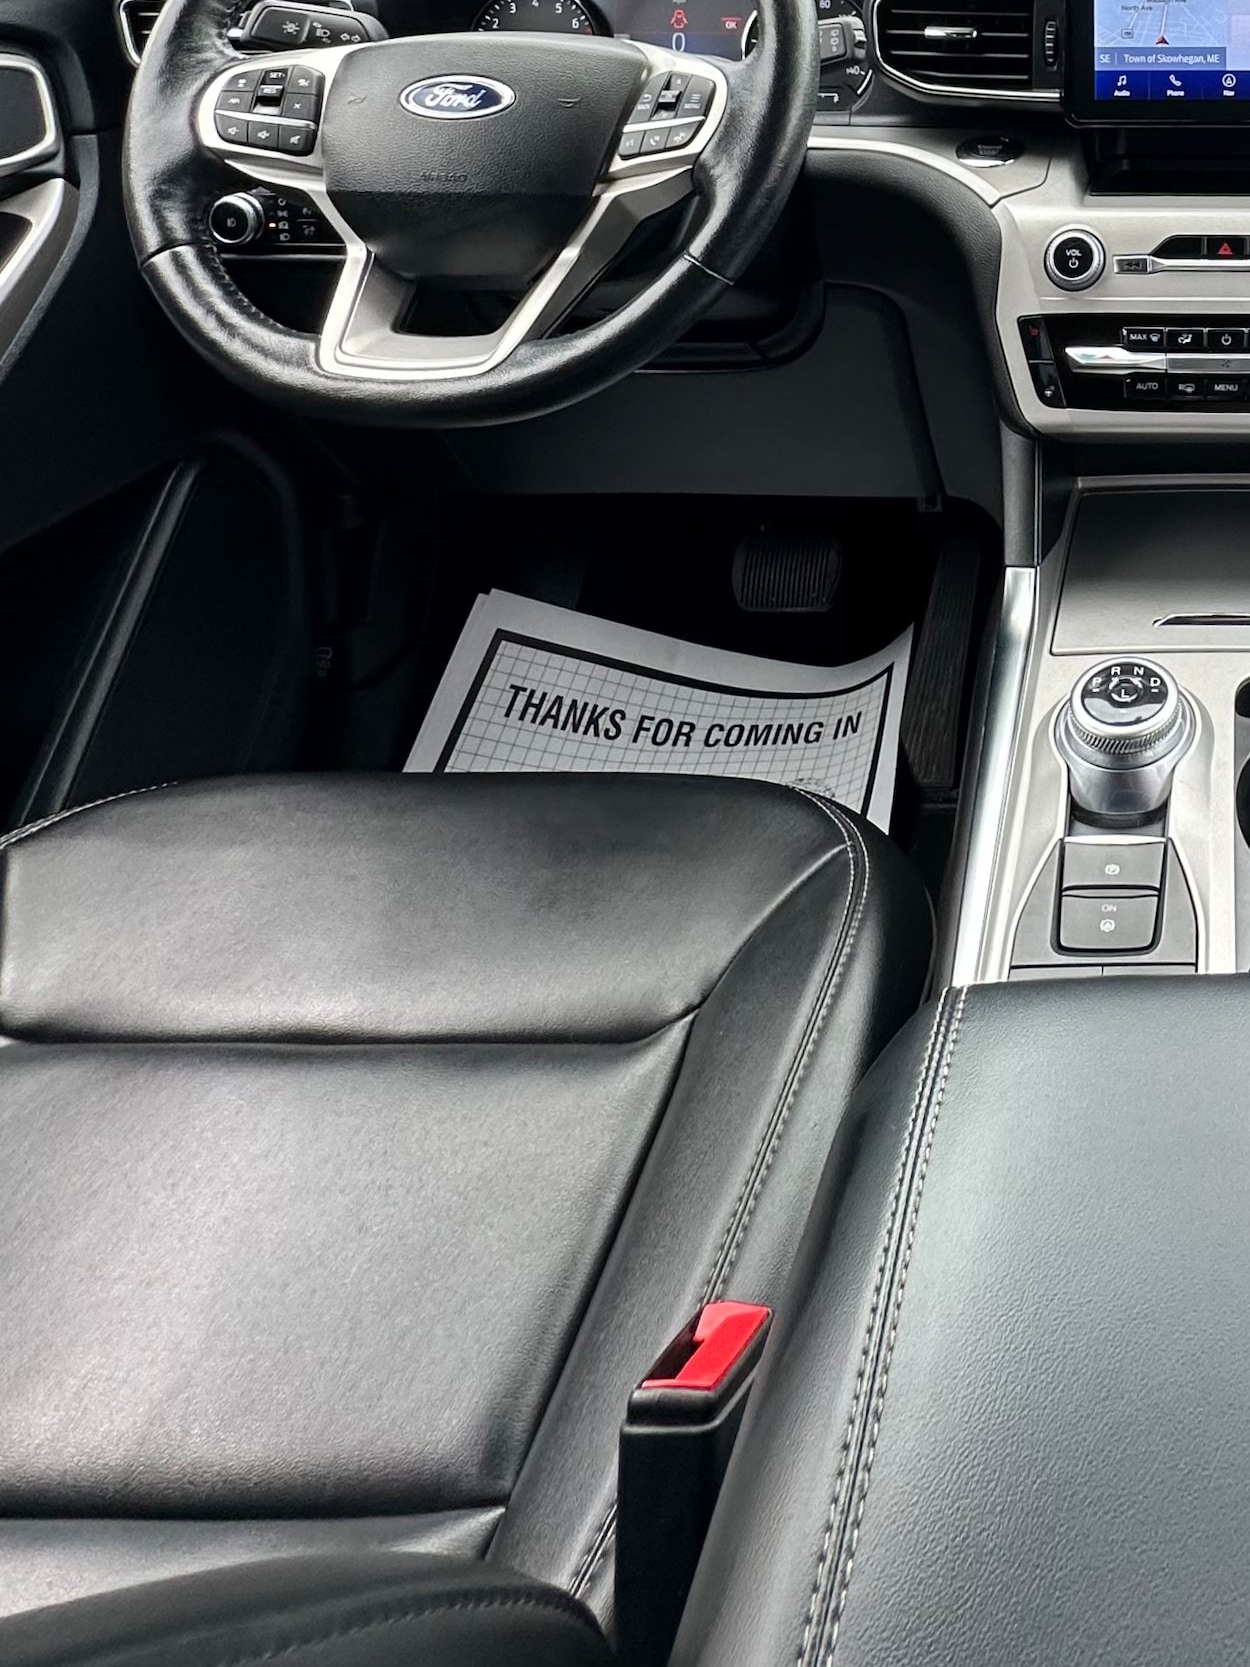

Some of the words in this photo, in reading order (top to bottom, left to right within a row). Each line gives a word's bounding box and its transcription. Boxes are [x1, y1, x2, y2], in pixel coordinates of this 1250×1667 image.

[509, 3, 516, 13] 3
[555, 3, 562, 13] 5
[820, 0, 831, 9] 80
[492, 18, 499, 29] 2
[572, 18, 580, 29] 6
[671, 32, 686, 52] 0
[1100, 54, 1111, 63] SE
[1124, 54, 1146, 63] Town
[1147, 54, 1156, 63] of
[1157, 54, 1206, 65] Skowhegan,
[1207, 54, 1220, 63] ME
[424, 83, 487, 108] Ford
[1065, 248, 1082, 256] VOL
[1130, 333, 1147, 341] MAX
[1136, 382, 1158, 390] AUTO
[1214, 383, 1238, 391] MENU
[1111, 666, 1121, 675] R
[1133, 666, 1144, 675] N
[1092, 677, 1102, 686] P
[1150, 677, 1160, 687] D
[1121, 689, 1130, 698] L
[503, 683, 626, 741] THANKS
[632, 714, 696, 747] FOR
[703, 721, 825, 748] COMING
[832, 710, 864, 740] IN
[1101, 904, 1117, 912] ON
